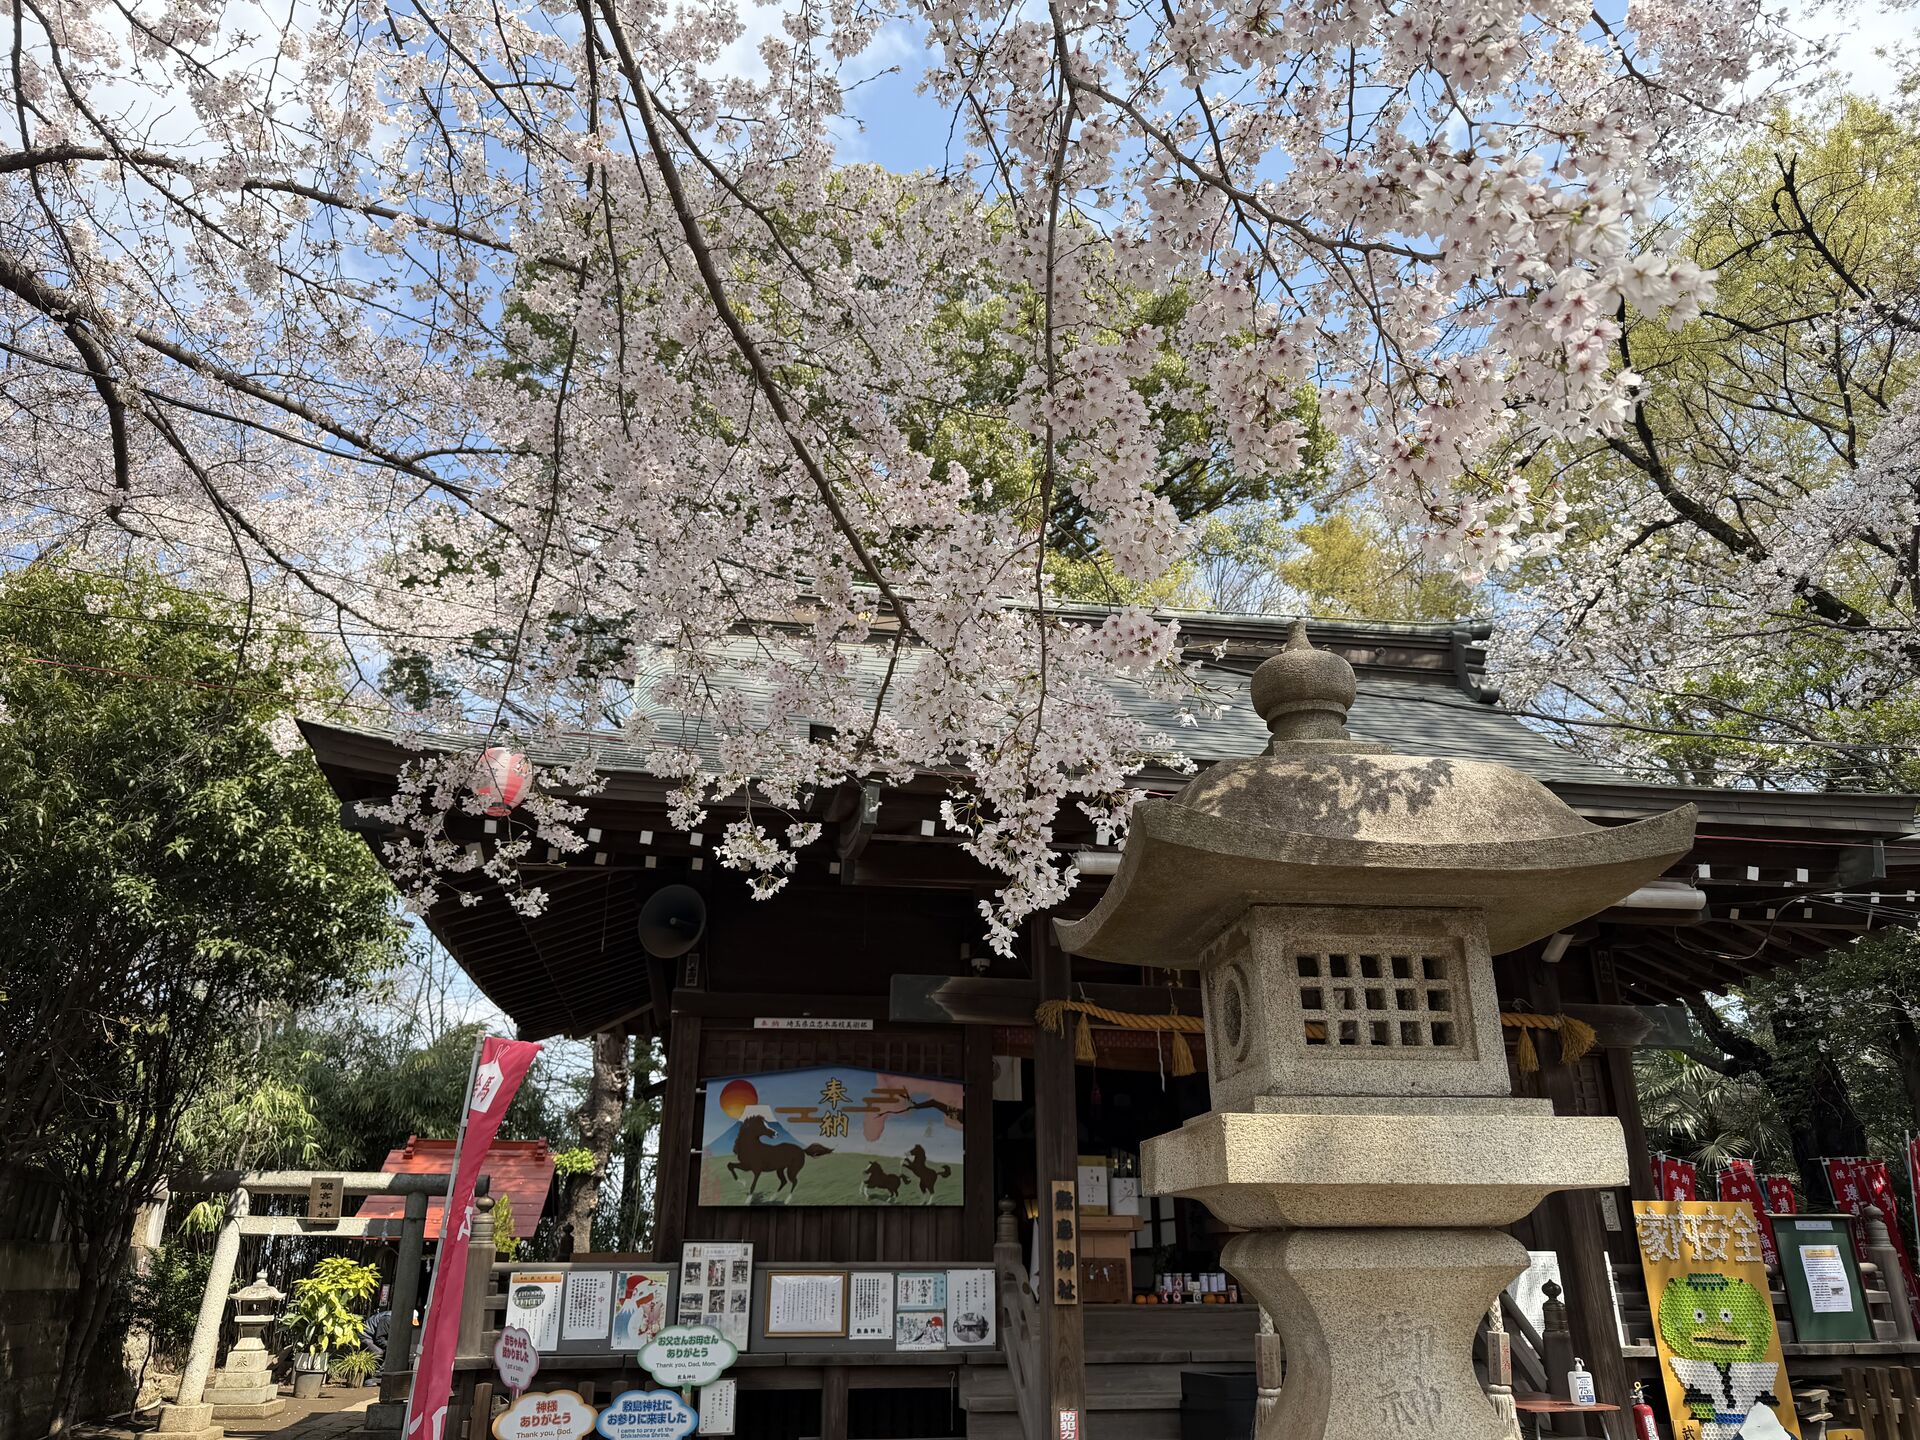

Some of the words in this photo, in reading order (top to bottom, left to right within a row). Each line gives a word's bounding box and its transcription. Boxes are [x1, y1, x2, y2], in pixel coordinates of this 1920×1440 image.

[819, 1077, 852, 1138] 奉納
[1635, 1205, 1761, 1262] 家内安全
[658, 1335, 719, 1346] お父さんお母さん
[666, 1347, 709, 1359] ありがとう
[536, 1400, 558, 1413] 神様
[622, 1400, 672, 1412] 敷島神社に
[520, 1412, 571, 1427] ありがとう
[607, 1412, 687, 1425] お参りに来ました
